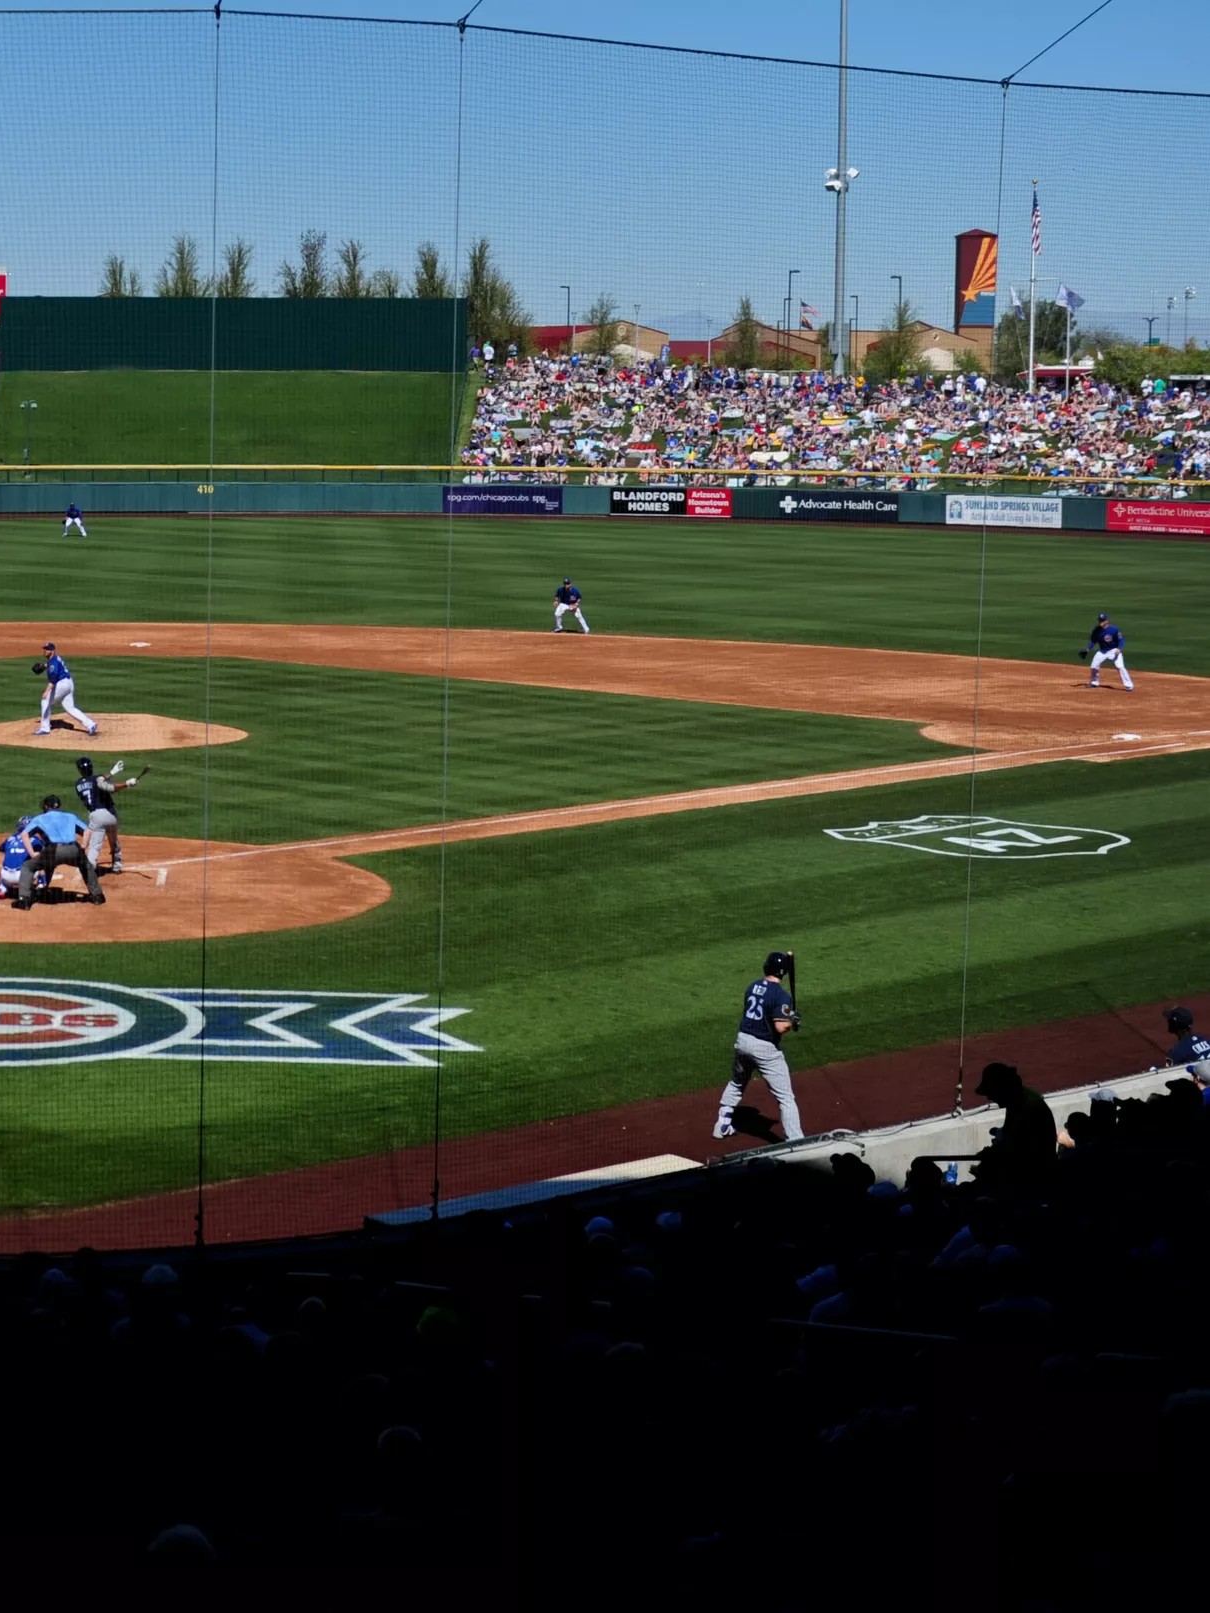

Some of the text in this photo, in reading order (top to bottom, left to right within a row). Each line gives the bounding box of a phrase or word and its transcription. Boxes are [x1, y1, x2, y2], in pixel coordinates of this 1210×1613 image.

[197, 484, 214, 494] 410
[692, 490, 726, 498] Arizona's
[447, 494, 530, 502] spg.com/chicagocubs
[612, 491, 685, 502] BLANDFORD
[628, 502, 670, 512] HOMES
[688, 498, 730, 506] Hometown
[798, 498, 898, 511] Advocate Health Care
[965, 500, 1060, 512] SUNLAND SPRINGS VILLAGE
[694, 506, 722, 514] Builder
[1128, 506, 1176, 516] Benedictine
[82, 790, 92, 805] 7
[746, 996, 763, 1020] 25
